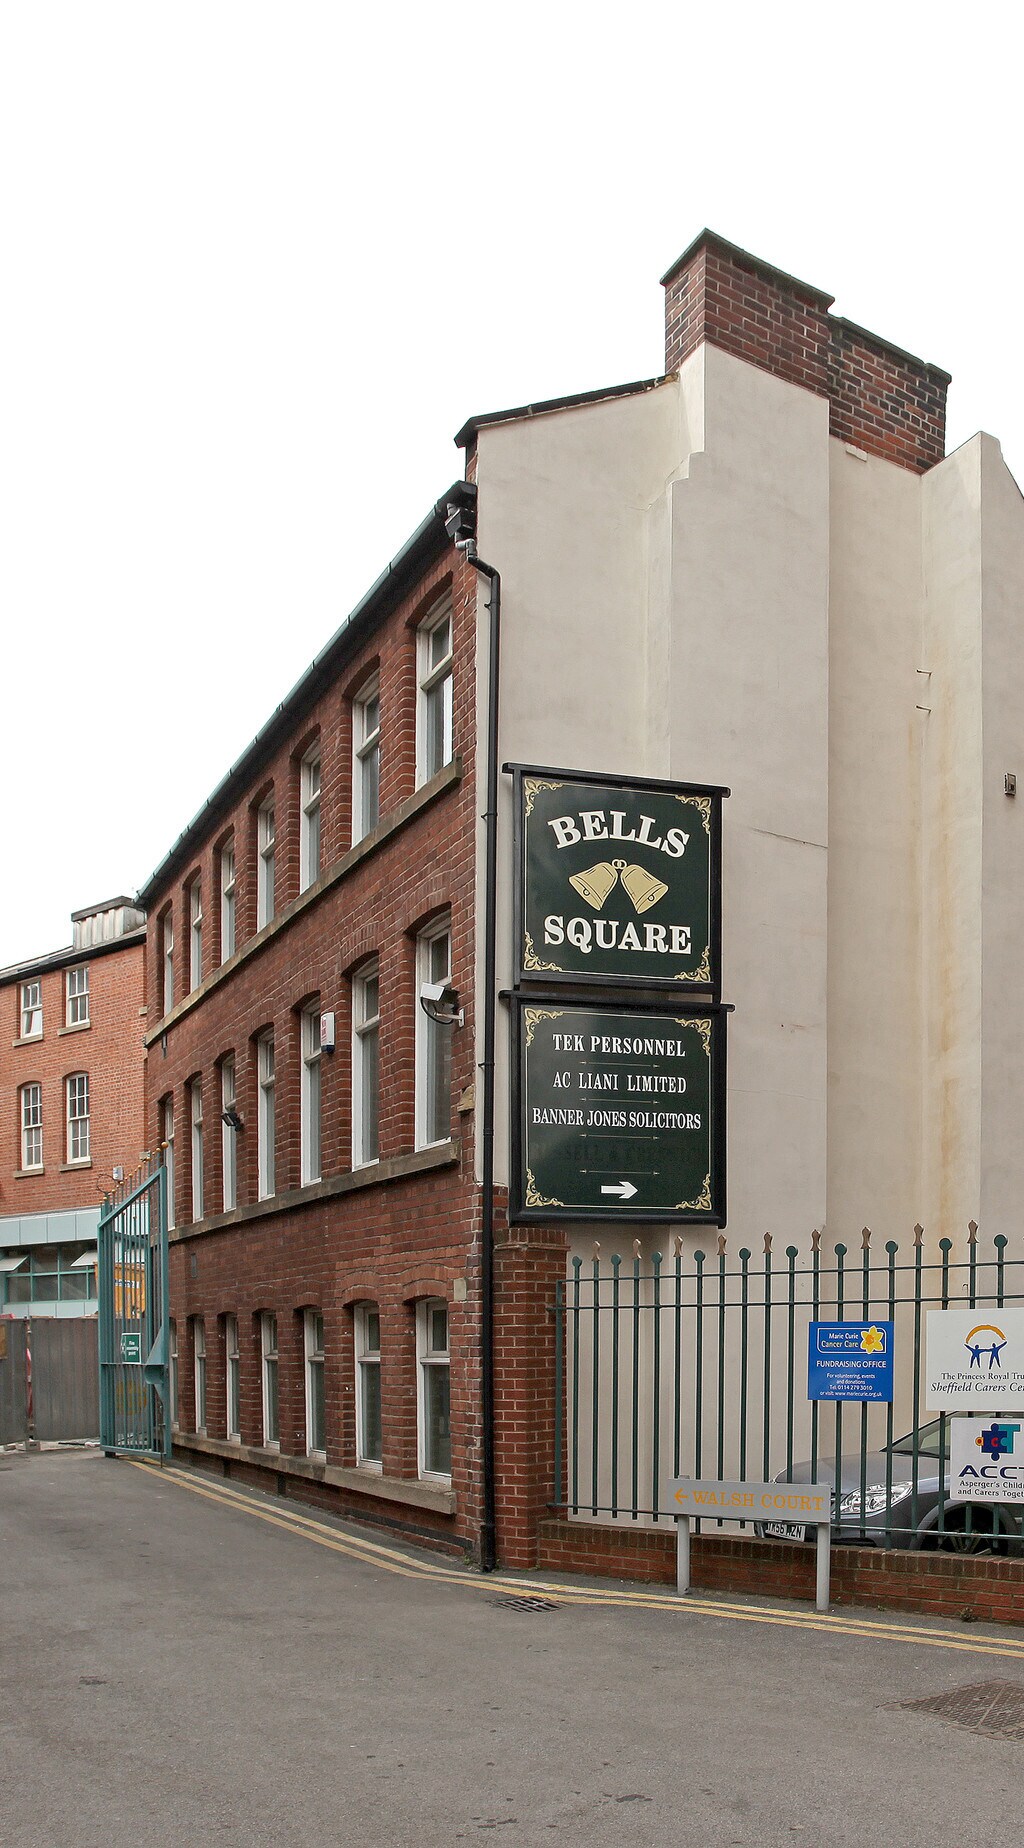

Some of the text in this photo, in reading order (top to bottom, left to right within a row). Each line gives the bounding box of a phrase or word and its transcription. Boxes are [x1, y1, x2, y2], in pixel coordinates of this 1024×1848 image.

[548, 810, 690, 858] BELLS
[544, 915, 691, 955] SQUARE
[552, 1034, 686, 1057] TEK PERSONNEL
[553, 1071, 687, 1094] AC LIANI LIMITED
[532, 1107, 701, 1130] BANNER JONES SOLICITORS
[845, 1332, 859, 1340] Curie
[821, 1340, 859, 1348] Cancer Care
[816, 1360, 861, 1368] FUNDRAISING
[941, 1372, 955, 1380] The
[957, 1372, 986, 1380] Princess
[988, 1372, 1010, 1381] Royal
[931, 1382, 972, 1394] Sheffield
[974, 1382, 1007, 1392] Carers
[959, 1480, 1000, 1489] Asperger's
[974, 1488, 1000, 1496] Carers
[692, 1490, 824, 1511] WALSH COURT
